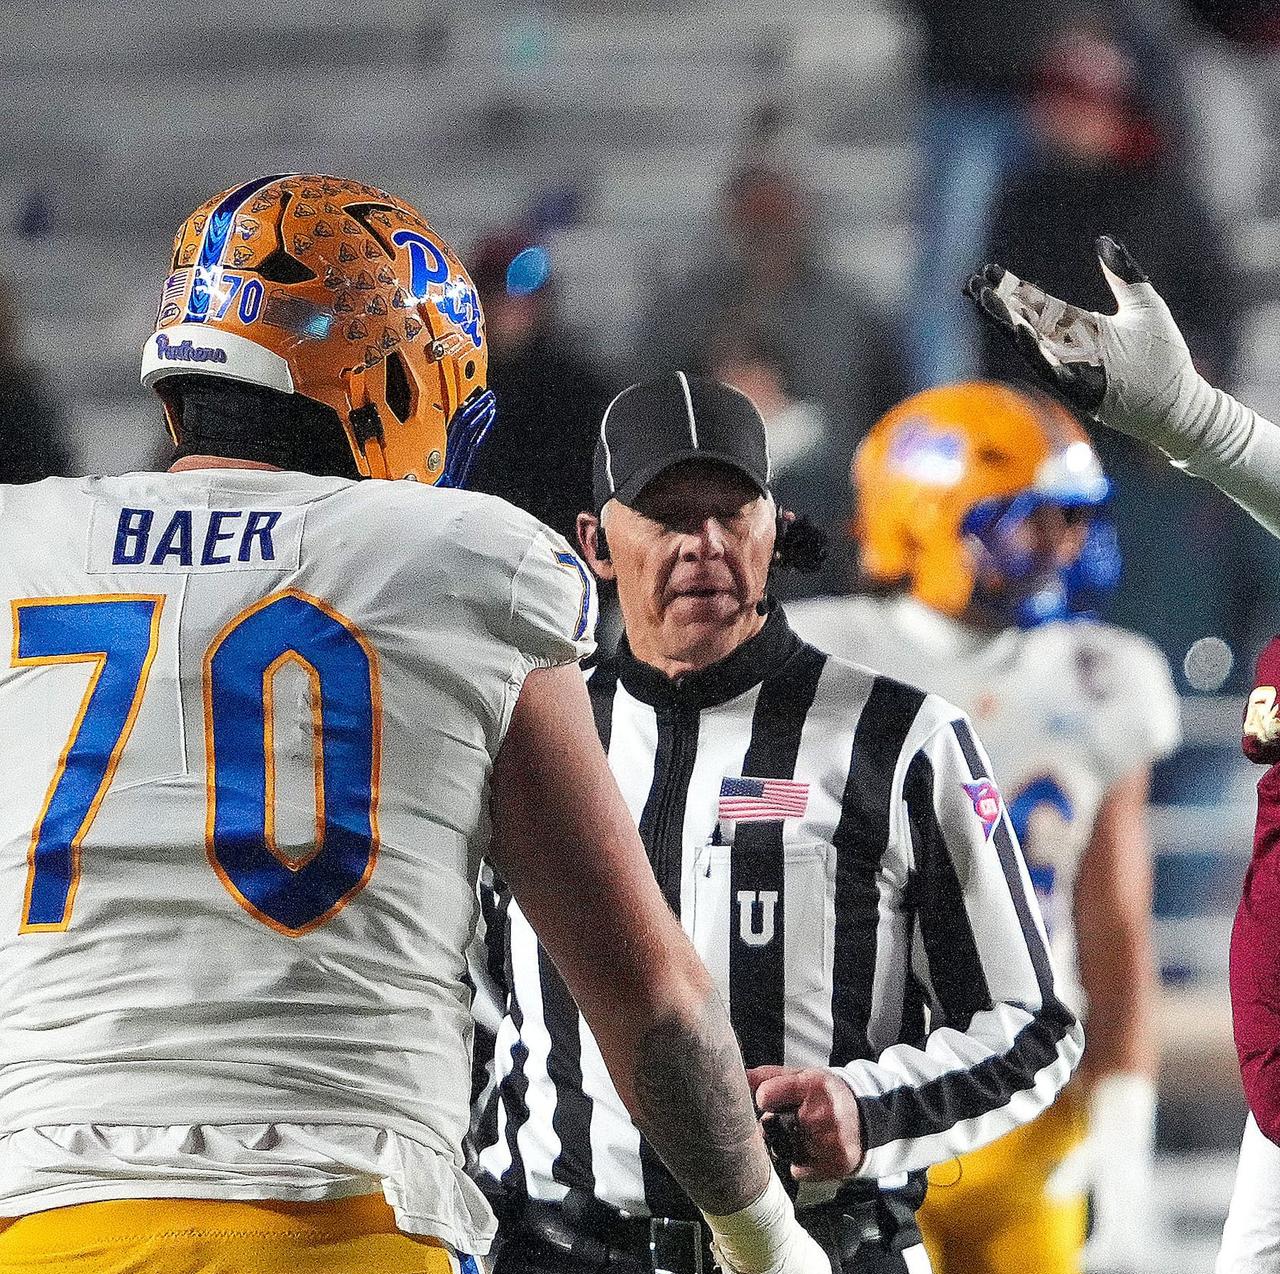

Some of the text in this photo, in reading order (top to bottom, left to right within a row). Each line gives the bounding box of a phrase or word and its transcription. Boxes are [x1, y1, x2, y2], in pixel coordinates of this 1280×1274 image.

[216, 274, 265, 325] 70
[111, 508, 283, 566] BAER
[10, 586, 384, 938] 70
[737, 891, 779, 947] U
